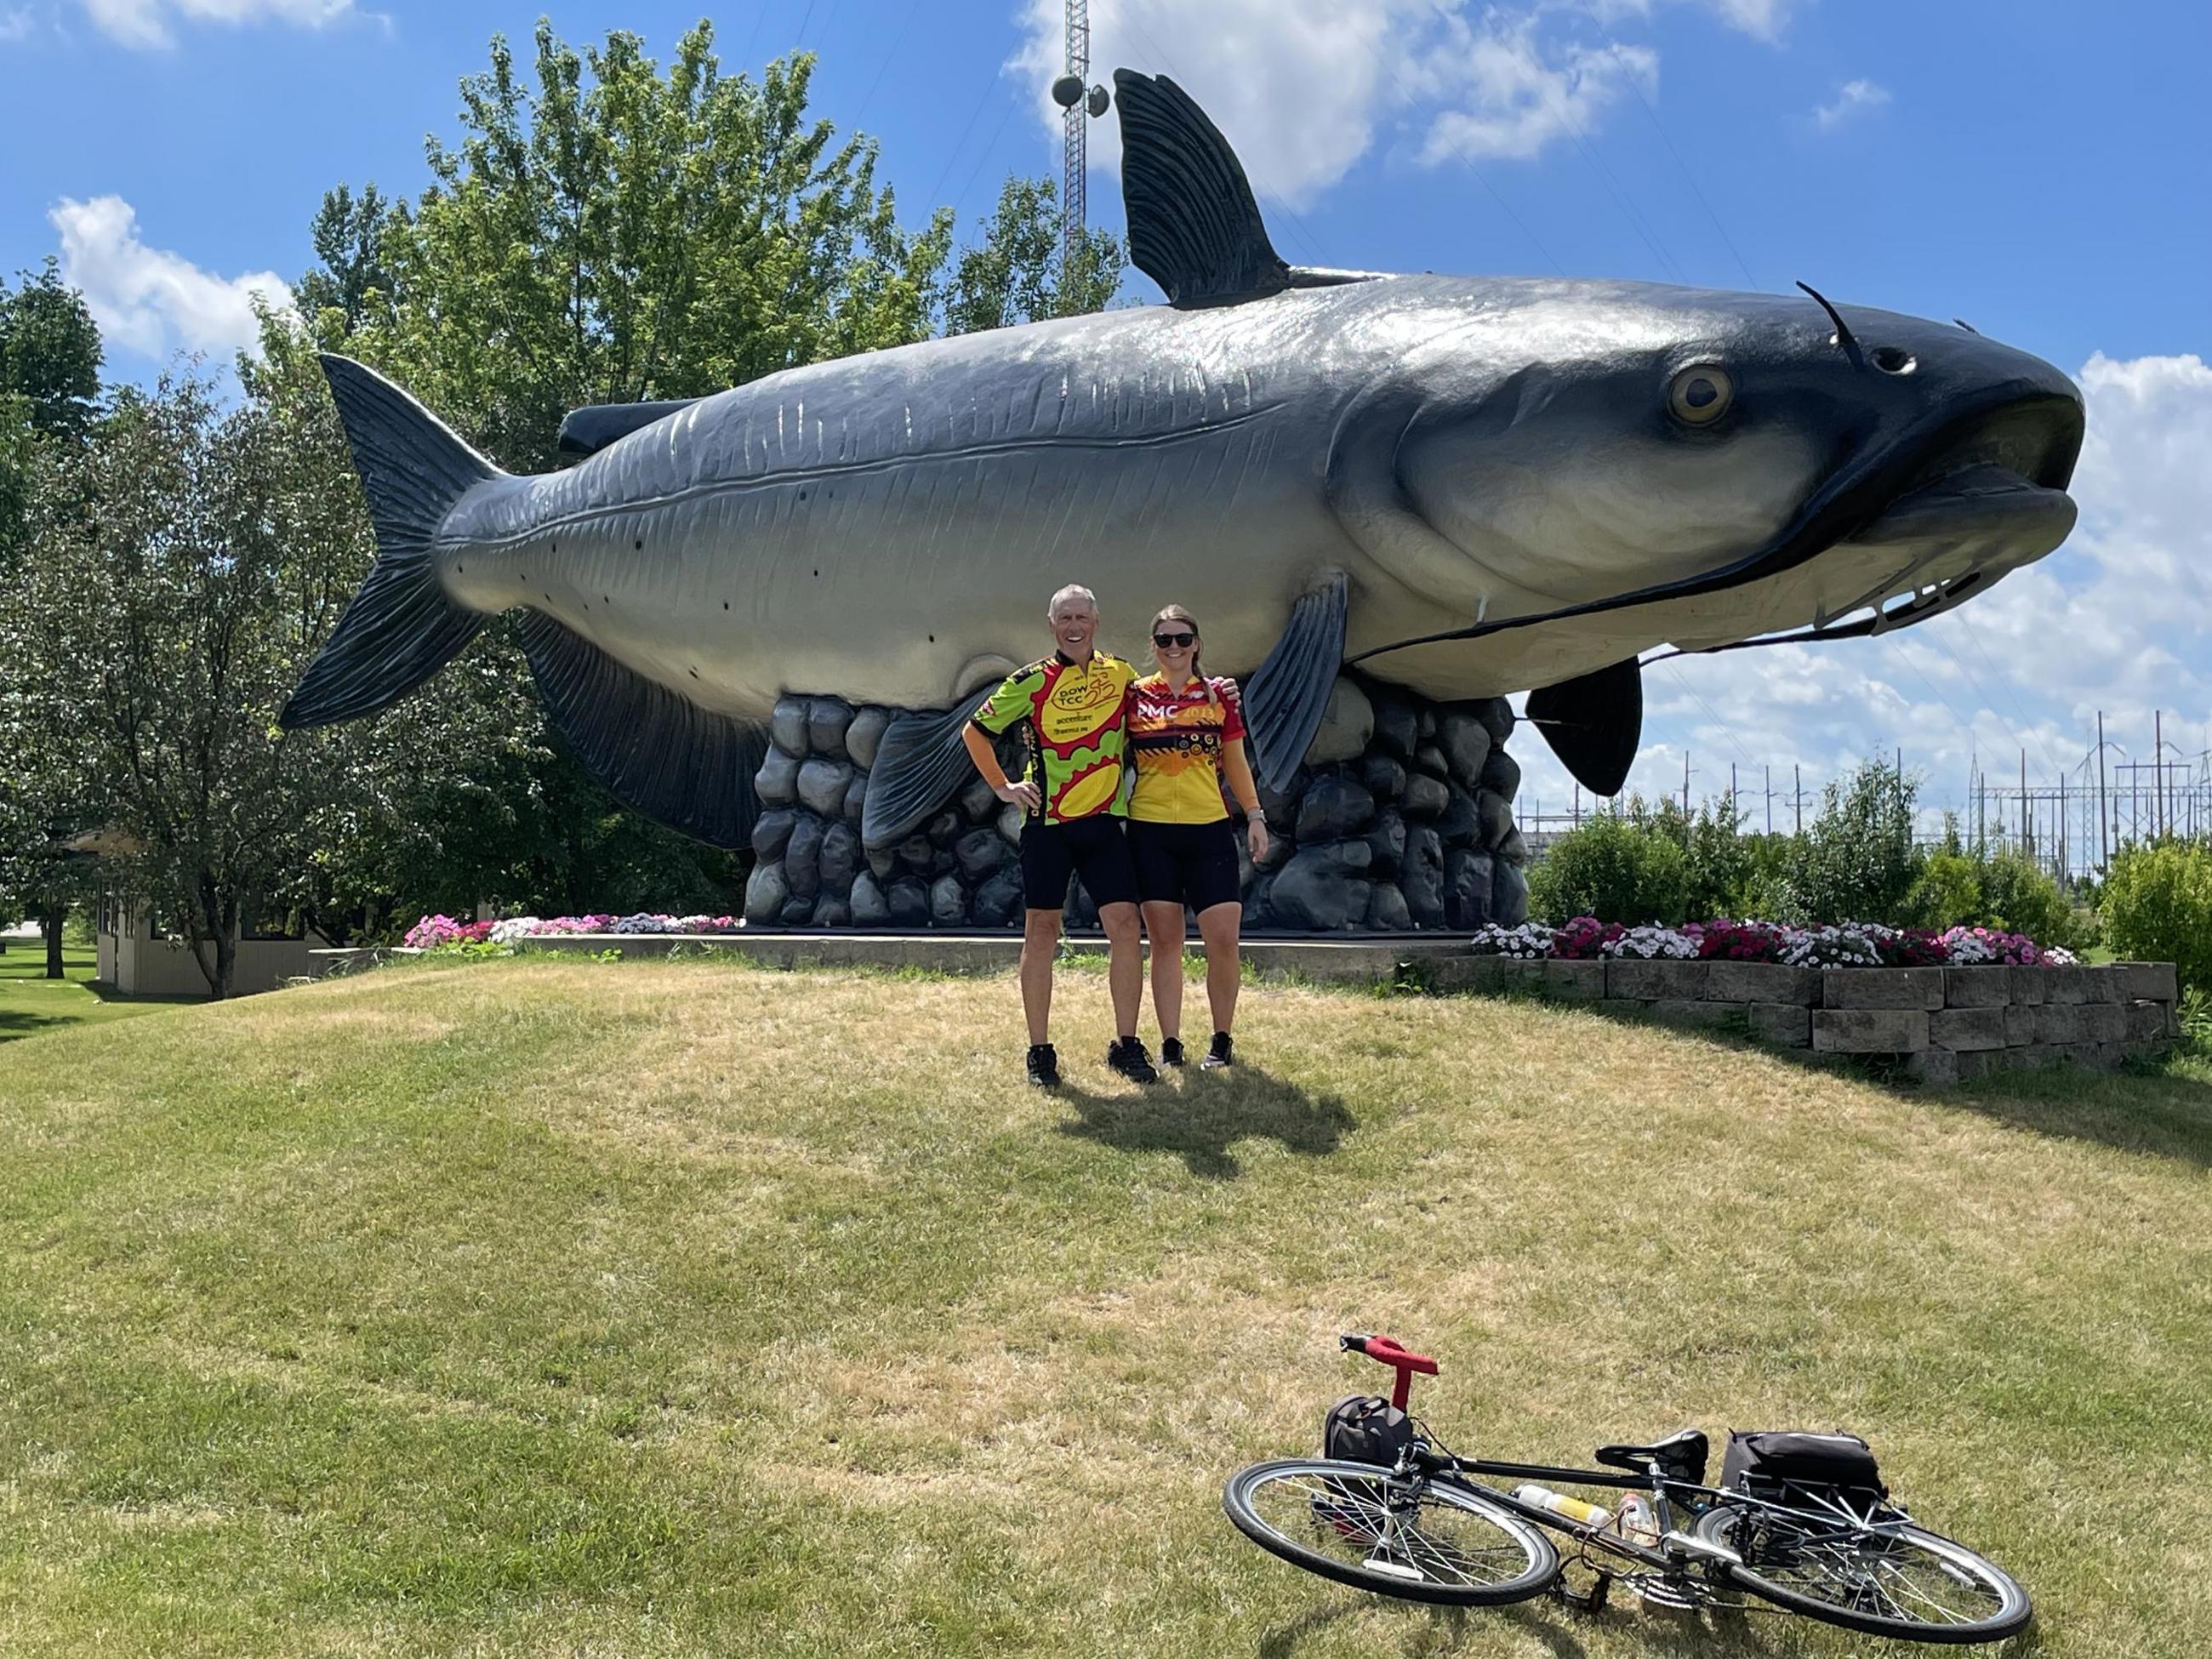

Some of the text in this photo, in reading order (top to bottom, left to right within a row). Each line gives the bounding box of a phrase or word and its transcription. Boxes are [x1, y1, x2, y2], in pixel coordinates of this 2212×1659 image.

[1059, 685, 1088, 697] DOW
[1059, 696, 1083, 706] TCC
[1137, 704, 1178, 719] PMC
